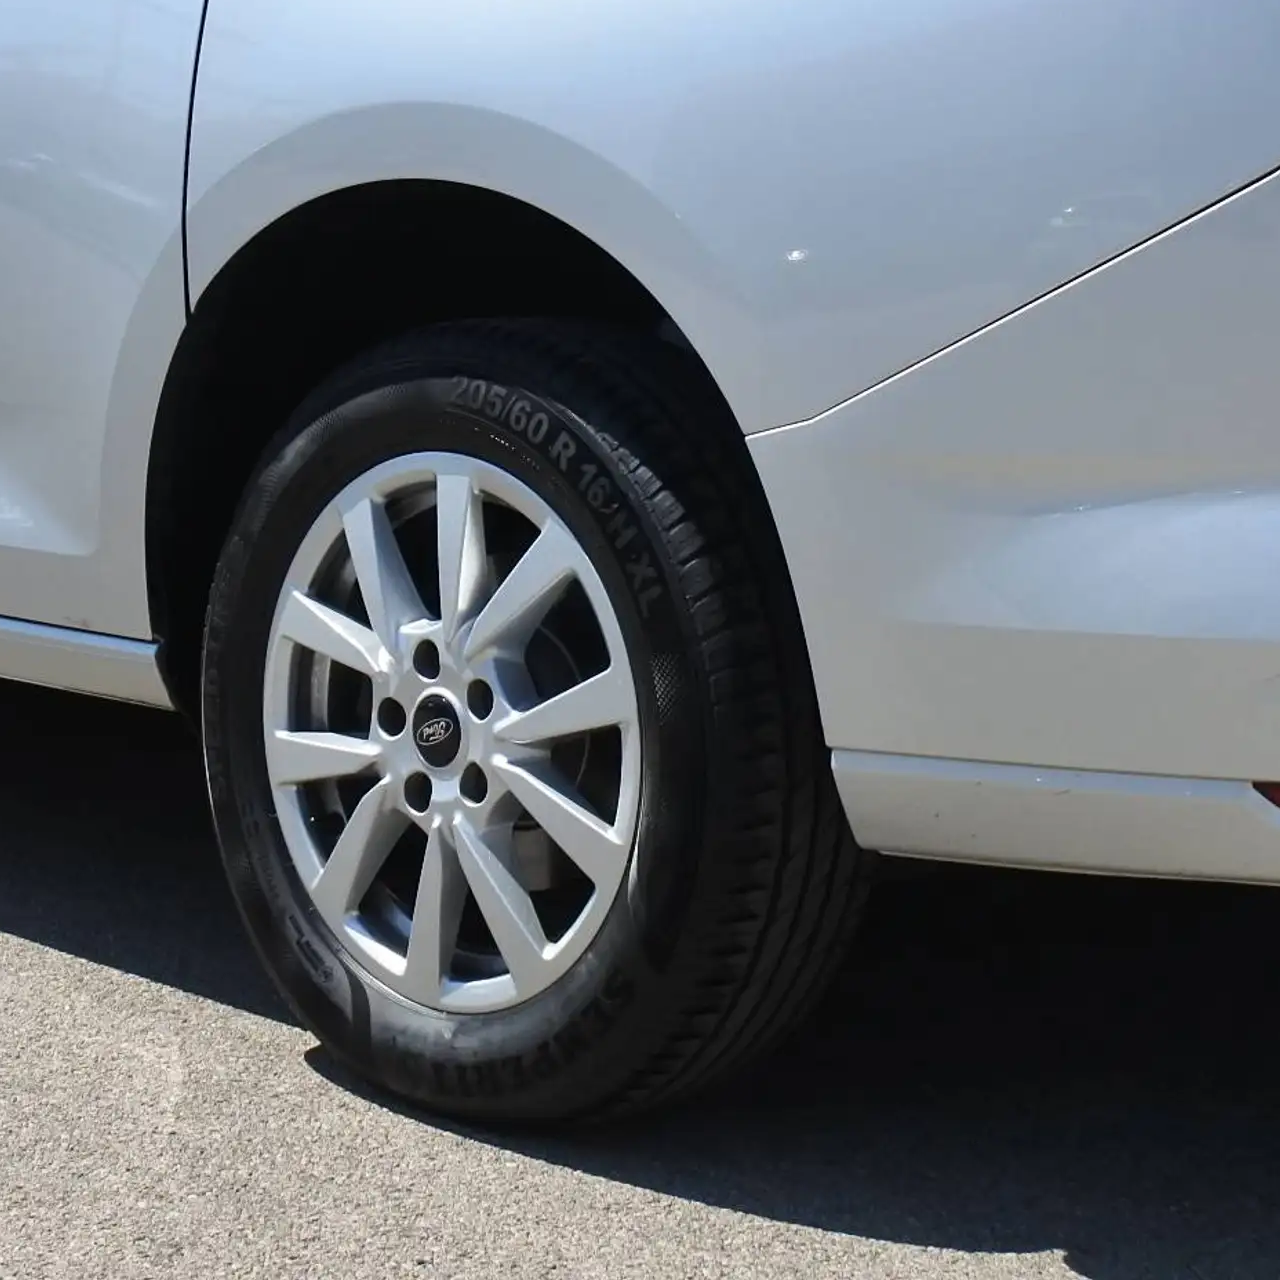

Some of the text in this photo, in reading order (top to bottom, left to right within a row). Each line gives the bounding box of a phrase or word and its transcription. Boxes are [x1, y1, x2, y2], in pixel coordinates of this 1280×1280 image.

[449, 376, 550, 445] 205/60
[549, 431, 577, 472] R
[421, 720, 448, 742] Ford
